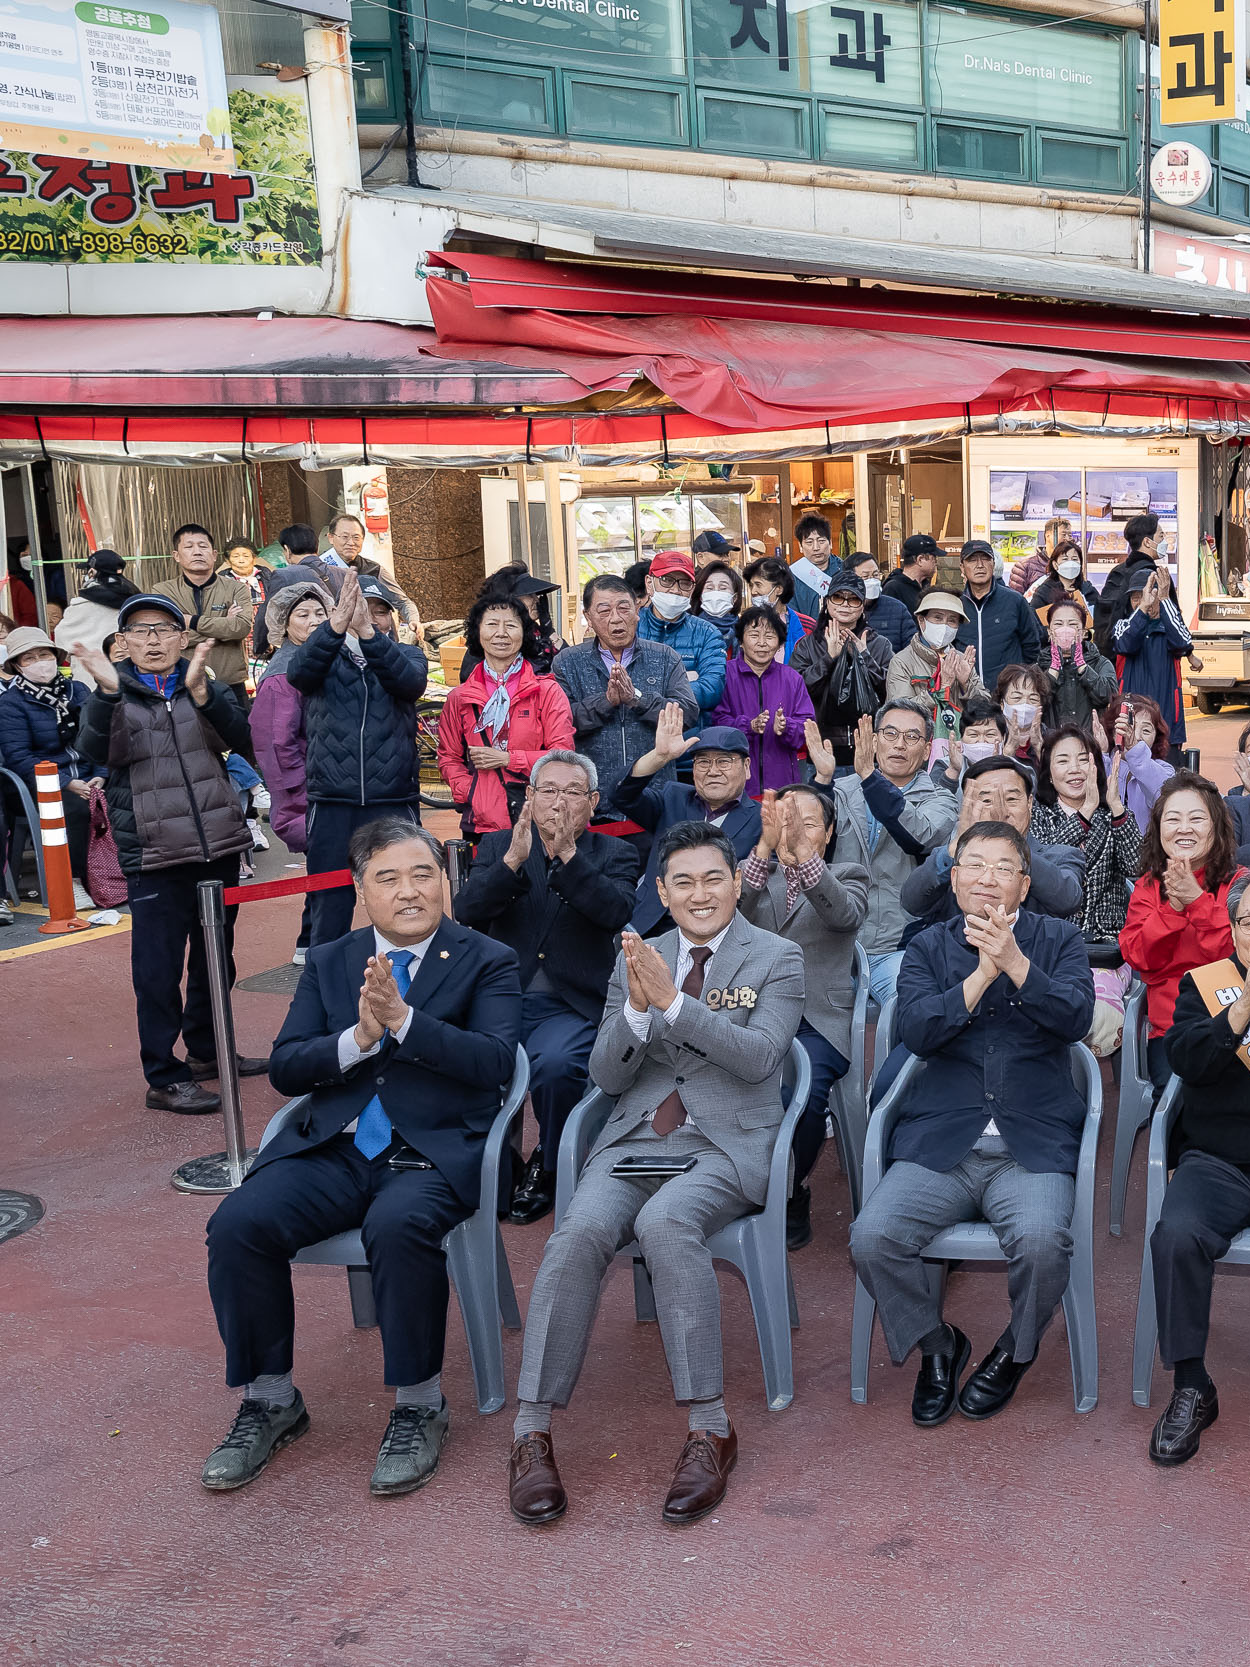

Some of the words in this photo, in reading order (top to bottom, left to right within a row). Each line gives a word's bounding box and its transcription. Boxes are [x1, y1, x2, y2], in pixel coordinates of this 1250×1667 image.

[94, 6, 152, 30] 경품추첨
[595, 1, 640, 21] Clinic
[730, 0, 891, 83] 치과
[134, 66, 198, 87] 쿠쿠전기밥솥
[963, 53, 1011, 74] Dr.Na's
[1014, 60, 1057, 81] Dental
[1059, 66, 1094, 86] Clinic
[135, 81, 199, 100] 삼천리자전거
[1155, 169, 1201, 187] 운수대통
[706, 986, 758, 1011] 오신환
